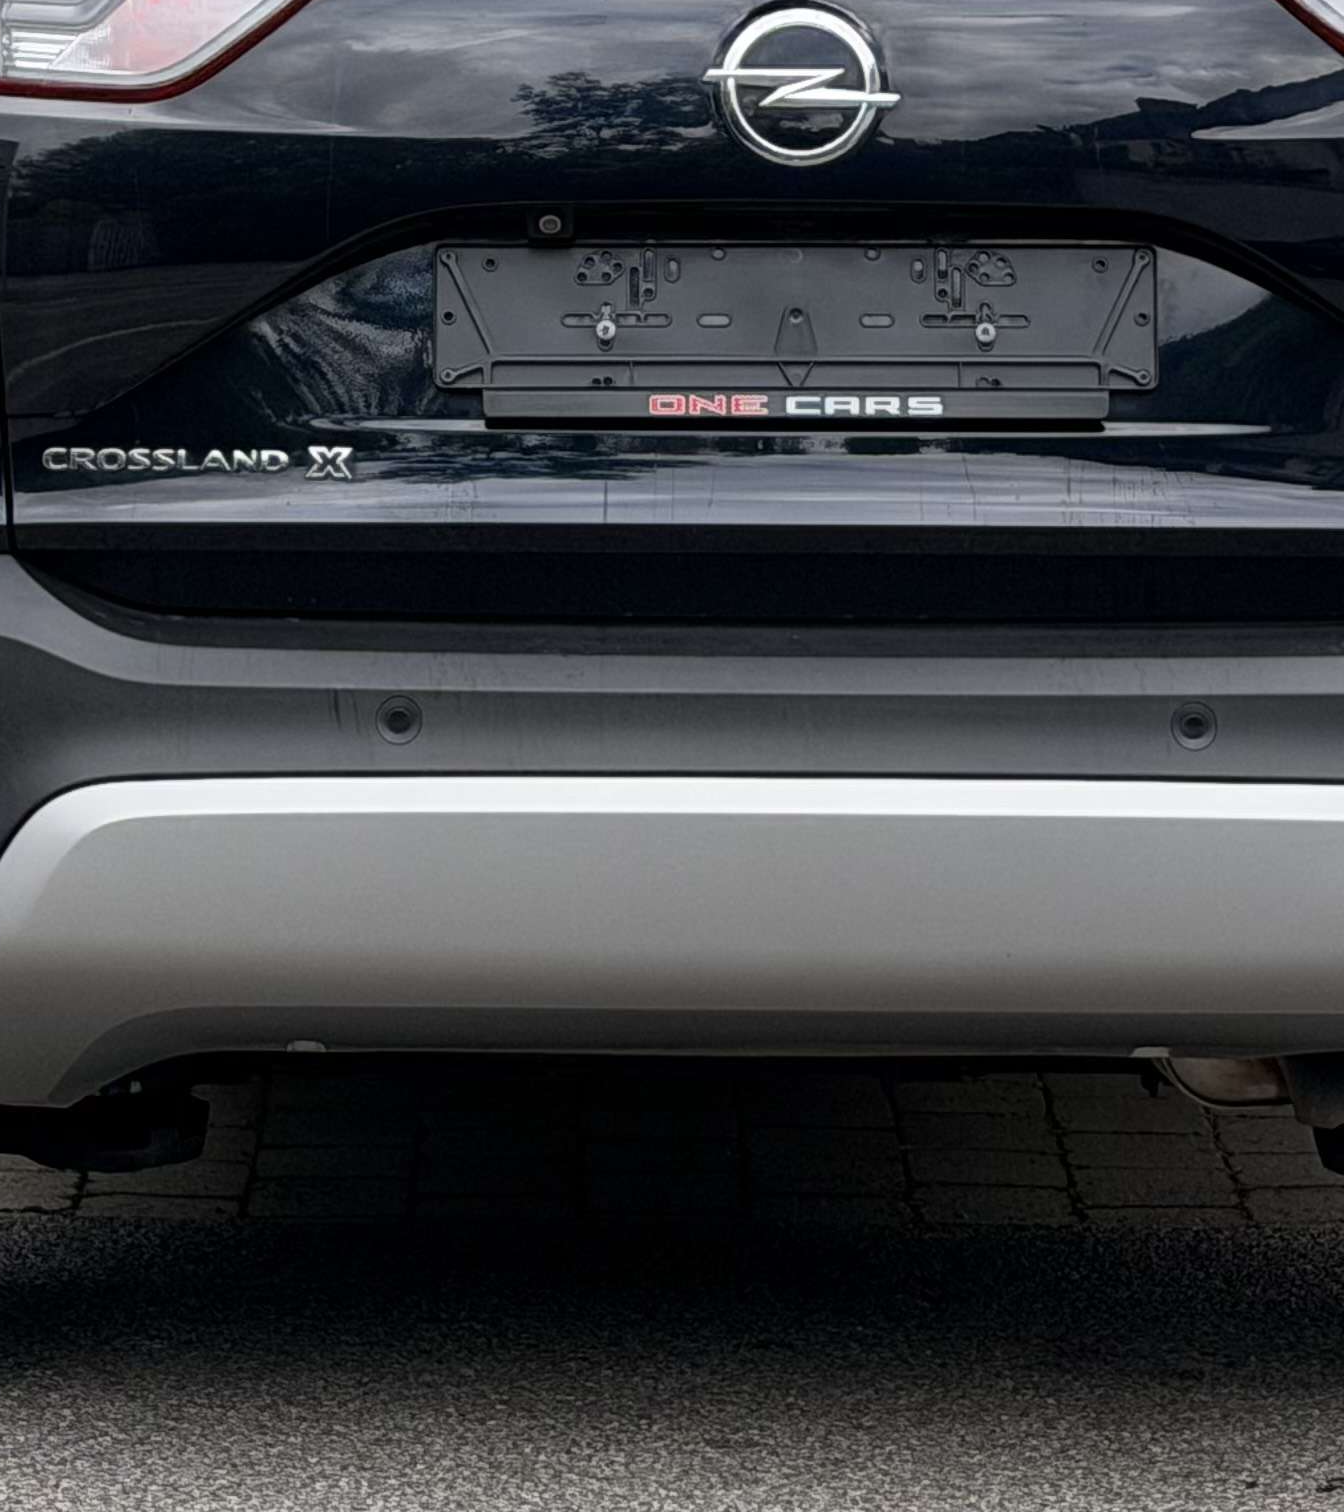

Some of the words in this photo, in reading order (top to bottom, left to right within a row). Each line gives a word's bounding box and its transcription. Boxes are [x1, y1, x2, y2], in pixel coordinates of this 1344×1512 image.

[649, 394, 769, 415] ONE
[785, 395, 944, 415] CARS
[42, 447, 289, 472] CROSSLAND
[305, 445, 353, 479] X
